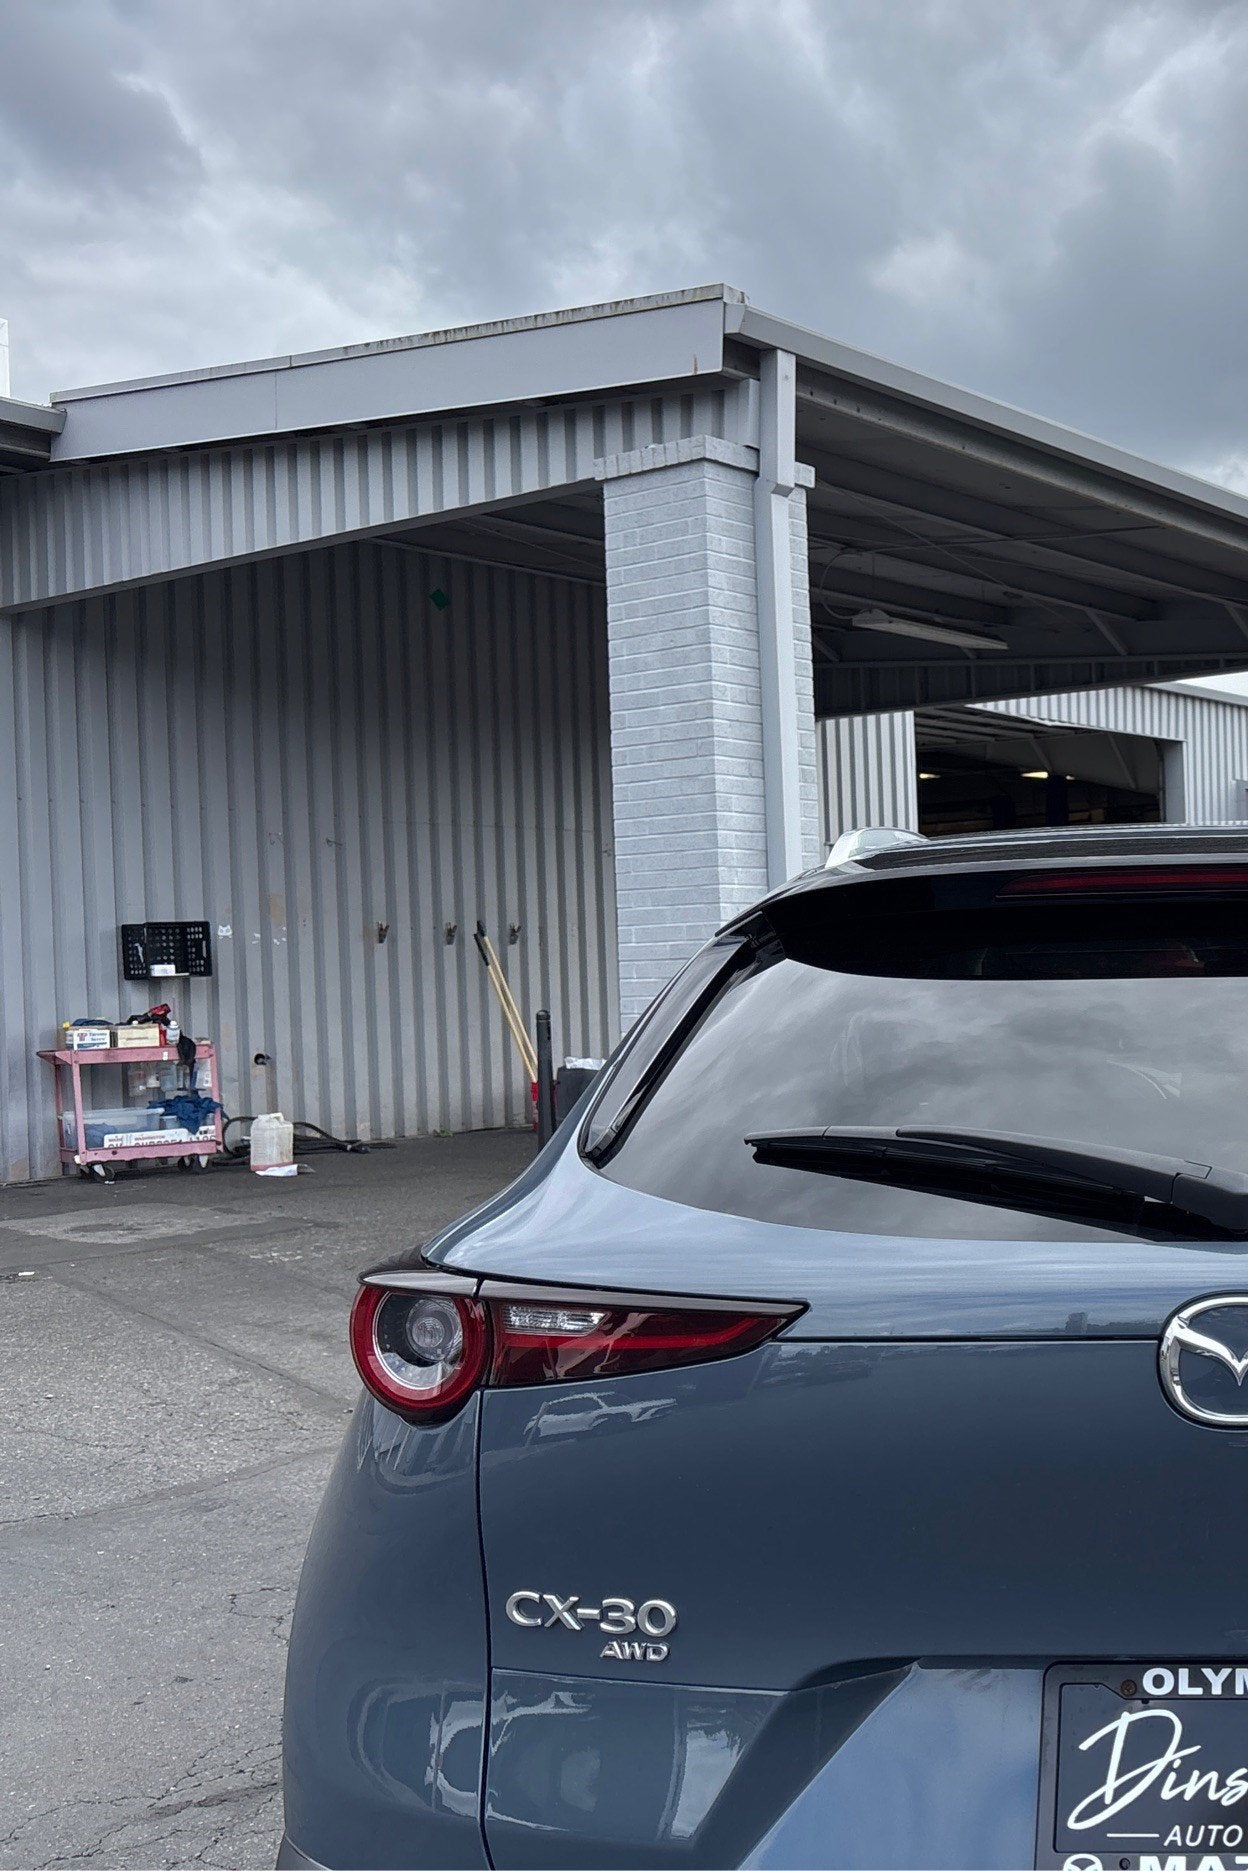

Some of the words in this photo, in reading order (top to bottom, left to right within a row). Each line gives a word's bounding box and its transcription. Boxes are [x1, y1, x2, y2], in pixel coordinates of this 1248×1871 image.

[505, 1590, 677, 1637] CX-30
[600, 1640, 670, 1662] AWD
[1163, 1824, 1243, 1847] AUTO
